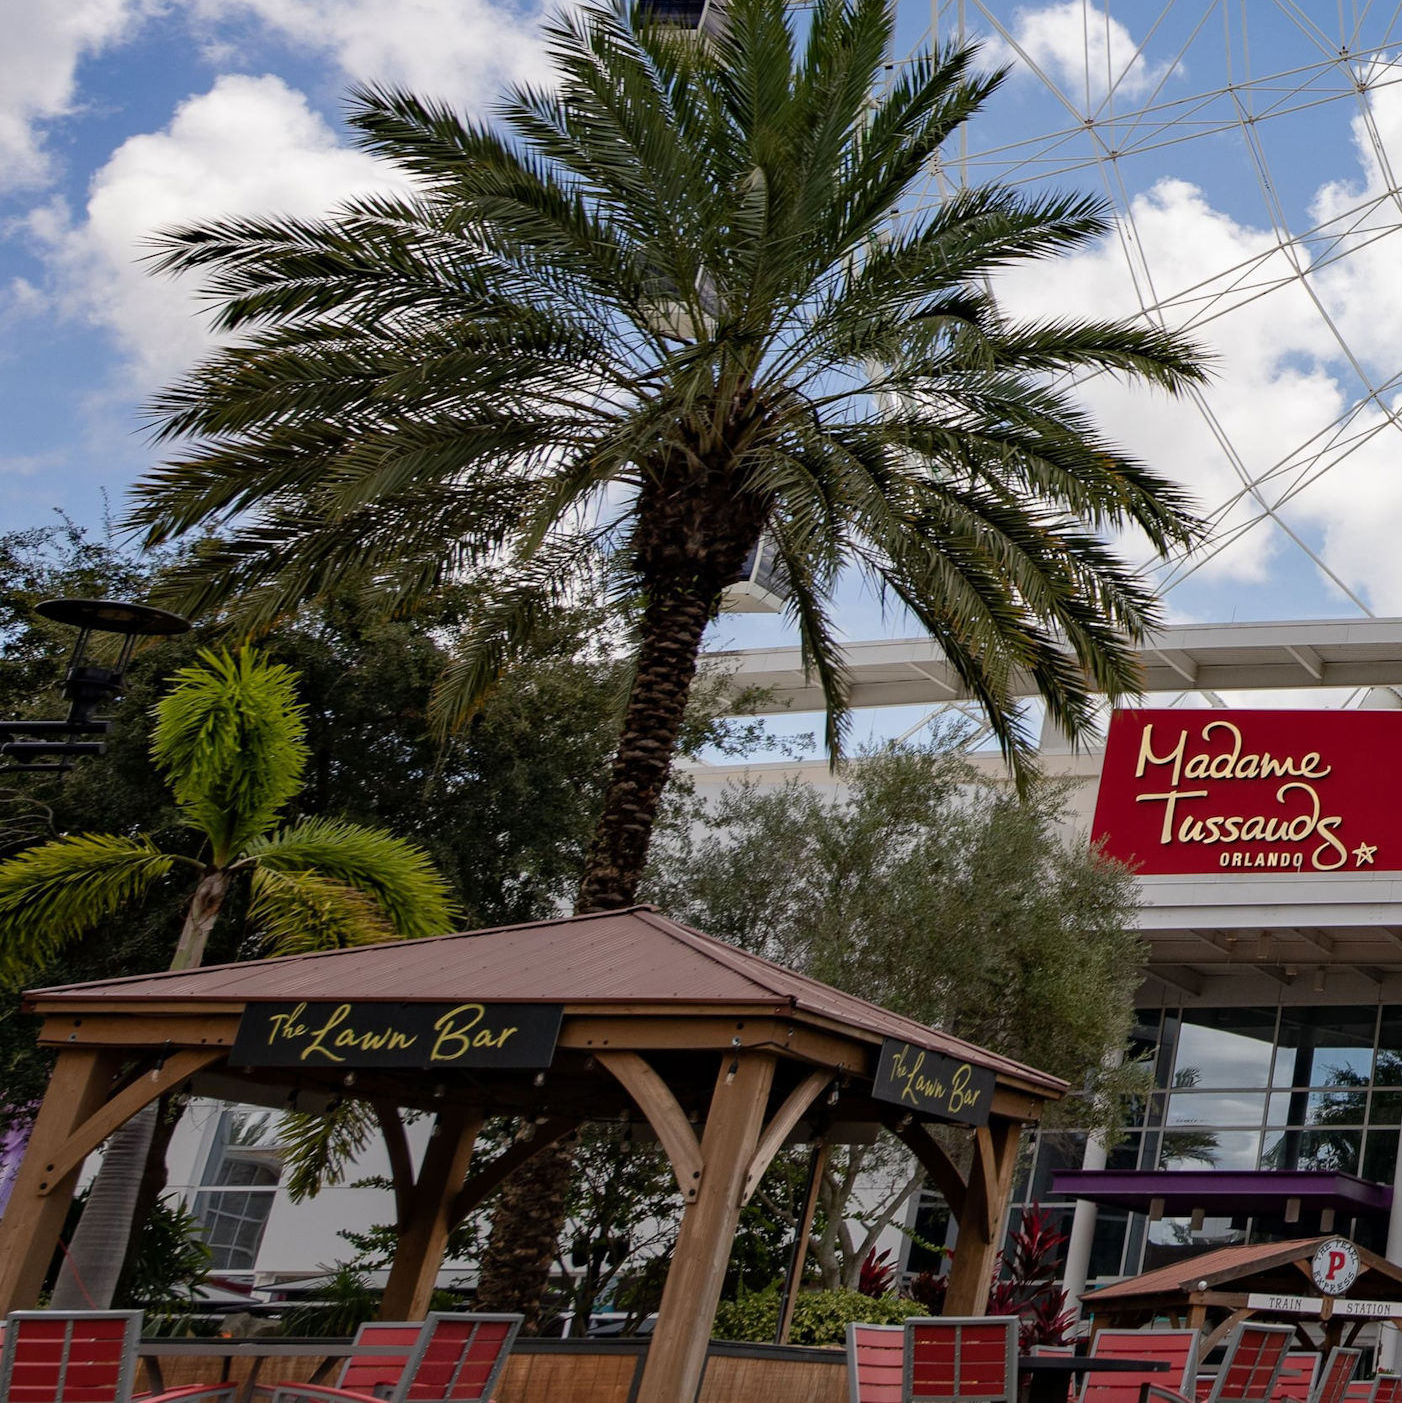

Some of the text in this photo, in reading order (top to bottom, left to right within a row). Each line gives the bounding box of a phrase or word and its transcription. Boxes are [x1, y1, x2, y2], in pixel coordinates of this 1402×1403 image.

[1135, 720, 1331, 786] Madame
[1135, 782, 1348, 871] Tussauds
[1219, 852, 1303, 867] ORLANDO
[268, 1002, 518, 1062] The Lawn Bar
[890, 1044, 981, 1113] The Lawn Bar
[1325, 1250, 1346, 1281] P
[1269, 1297, 1391, 1315] TRAIN STATION
